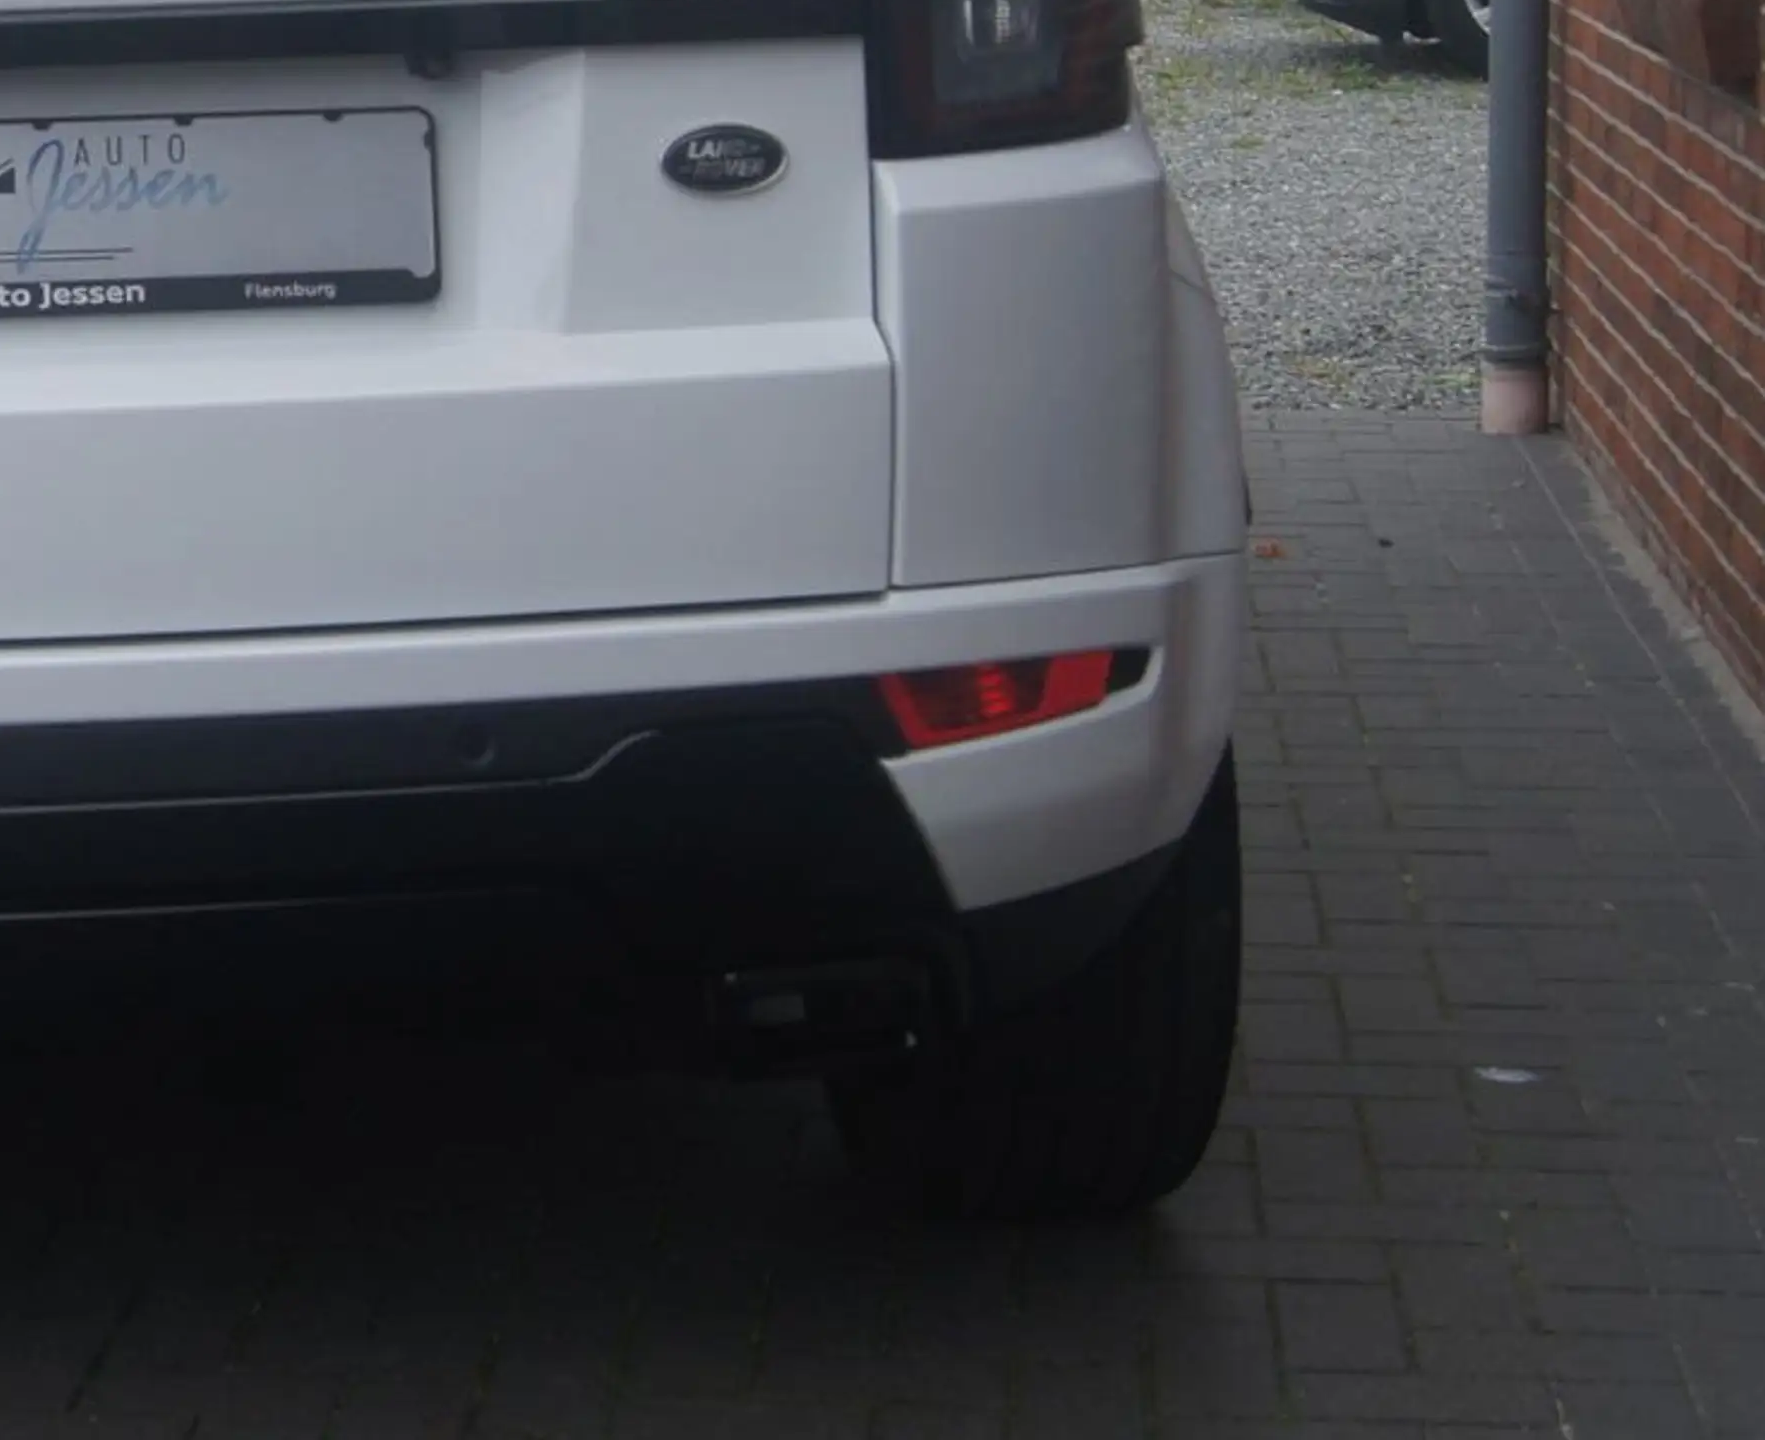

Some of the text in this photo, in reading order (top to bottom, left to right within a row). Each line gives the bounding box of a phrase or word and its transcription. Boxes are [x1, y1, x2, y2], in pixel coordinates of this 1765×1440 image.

[73, 133, 186, 166] AUTO
[16, 139, 231, 274] Jessen
[38, 282, 146, 310] Jessen
[244, 279, 336, 300] Flensburg
